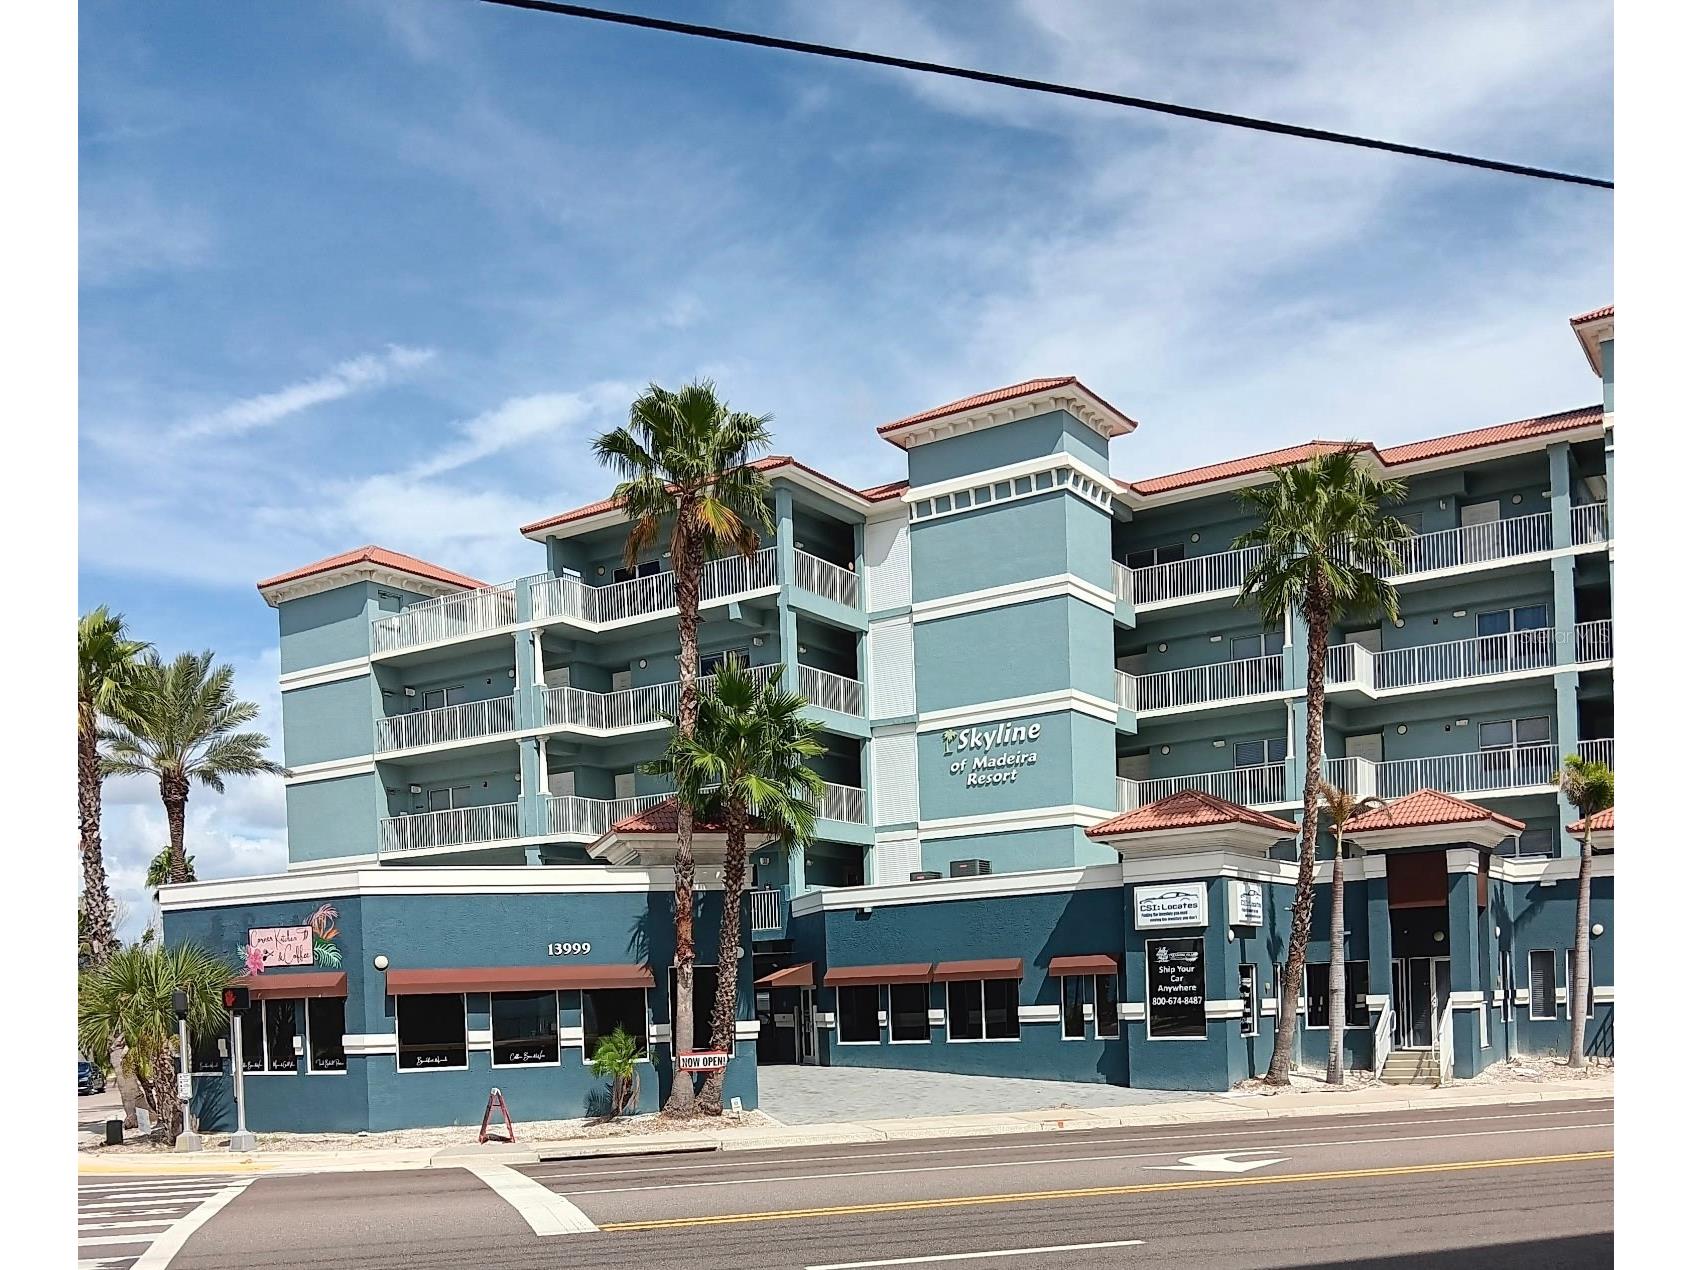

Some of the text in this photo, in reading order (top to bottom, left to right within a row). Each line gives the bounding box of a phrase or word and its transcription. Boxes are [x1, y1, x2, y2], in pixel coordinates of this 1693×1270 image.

[957, 722, 1041, 752] Skyline
[950, 751, 1037, 773] of Madeira
[967, 769, 1018, 786] Resort
[548, 942, 591, 956] 13999
[1158, 965, 1195, 974] Ship Your
[1170, 974, 1184, 982] Car
[1157, 984, 1197, 993] Anywhere
[1152, 996, 1203, 1006] 800-674-8487
[682, 1056, 726, 1067] NOW OPEN!
